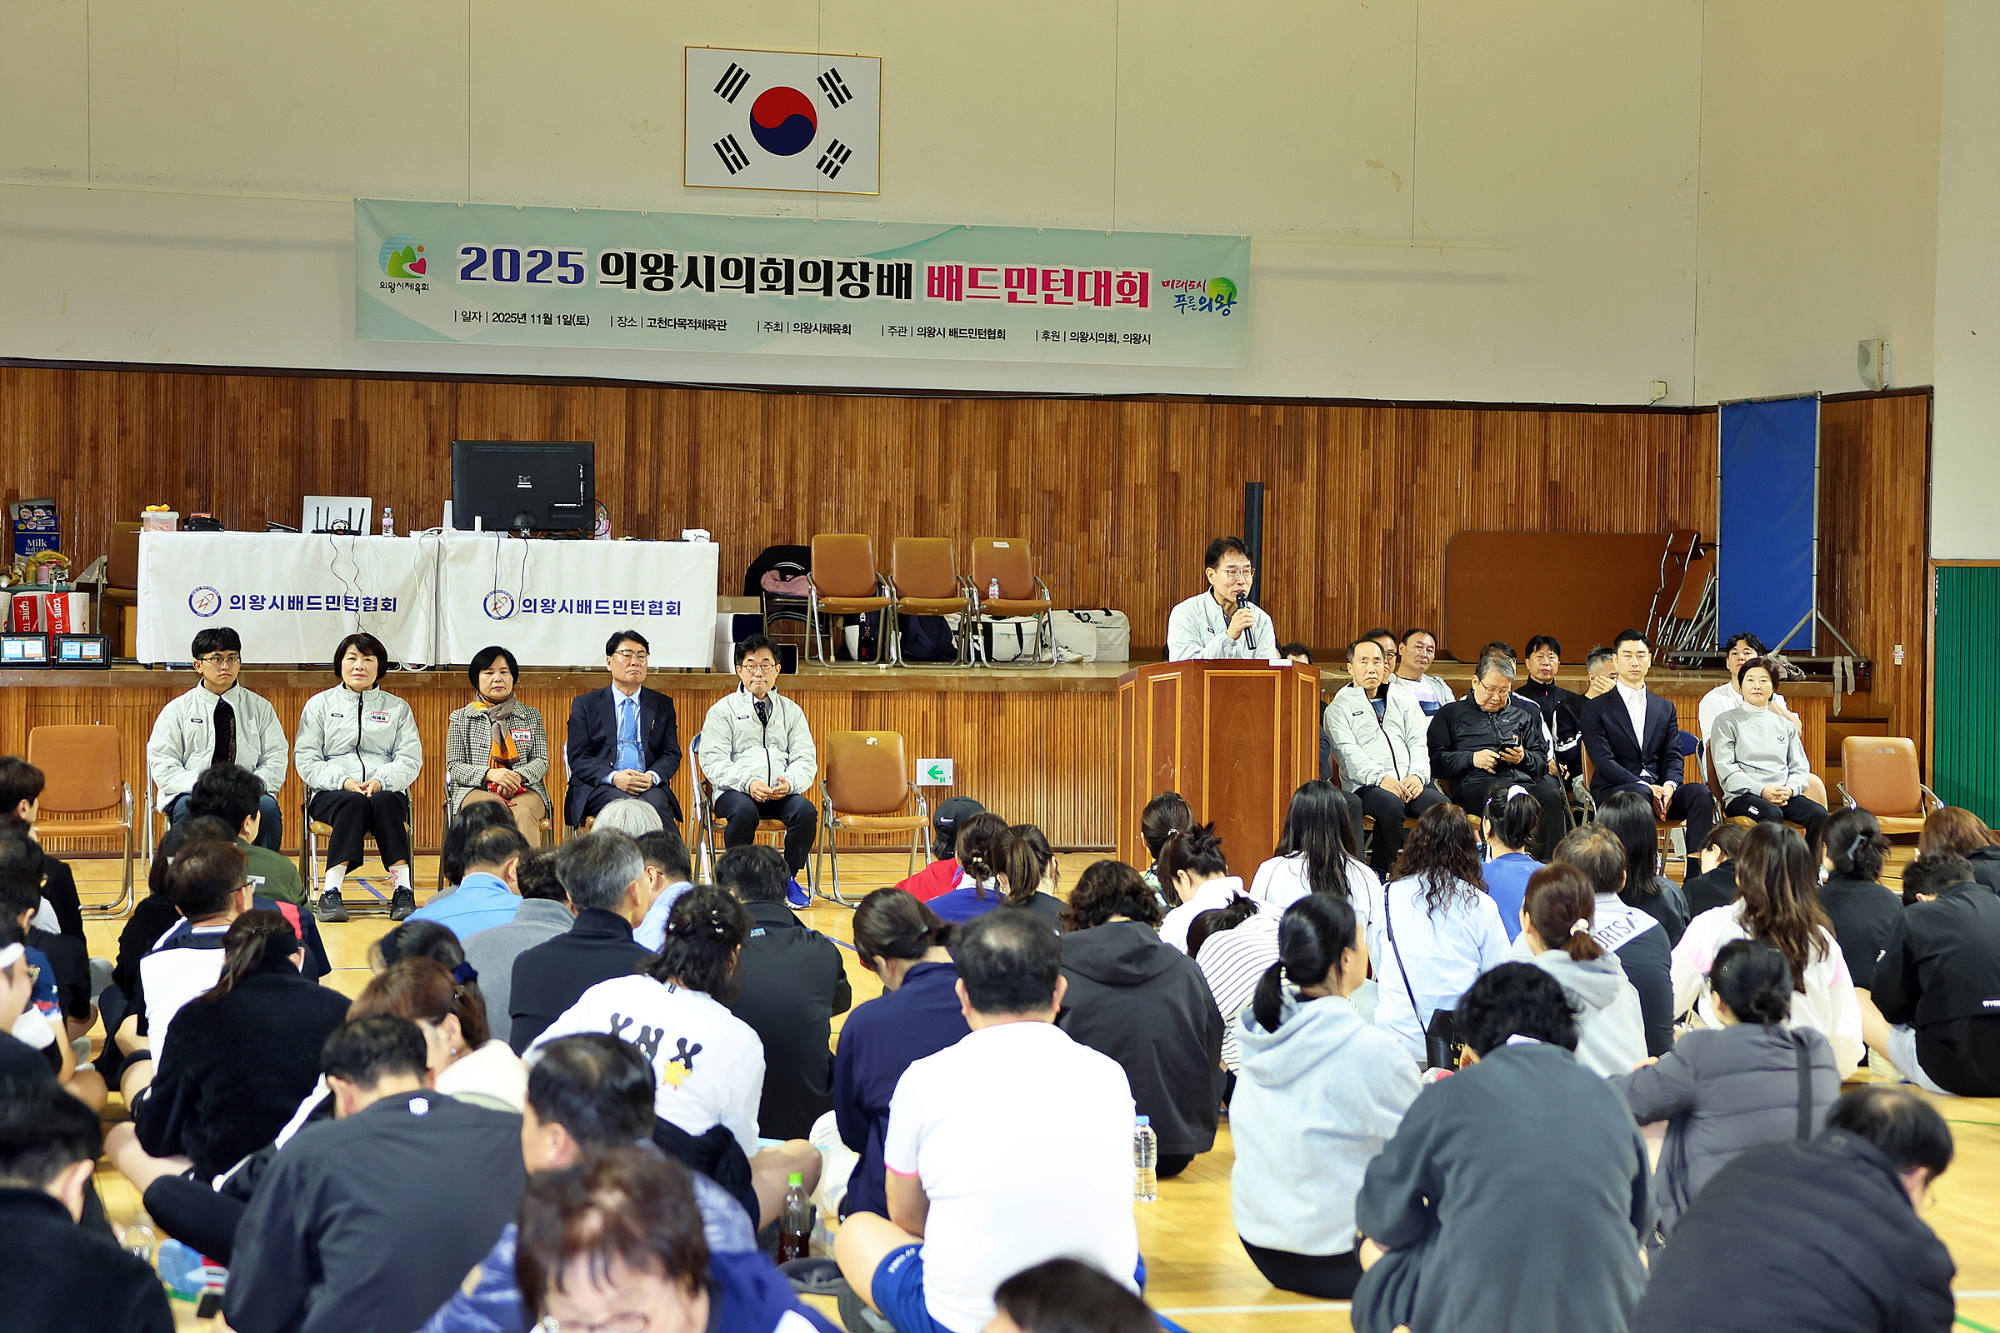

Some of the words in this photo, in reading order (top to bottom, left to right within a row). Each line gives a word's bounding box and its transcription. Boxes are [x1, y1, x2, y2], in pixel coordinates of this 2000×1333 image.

[460, 246, 585, 285] 2025
[600, 251, 913, 300] 의왕시의회의장배
[926, 264, 1149, 308] 배드민턴대회
[1161, 278, 1207, 293] 미래도시
[461, 310, 482, 323] 일자
[492, 312, 527, 324] 2025년
[530, 313, 553, 326] 11월
[556, 313, 590, 327] 1일(토)
[617, 316, 638, 328] 장소
[646, 317, 728, 331] 고천다목적체육관
[763, 321, 783, 333] 주최
[792, 322, 852, 335] 의왕시체육회
[887, 325, 908, 337] 주관
[916, 326, 946, 339] 의왕시
[948, 327, 1006, 341] 배드민턴협회
[1041, 330, 1061, 342] 후원
[1069, 331, 1120, 344] 의왕시의회,
[1122, 333, 1151, 345] 의왕시
[26, 538, 48, 547] Milk
[21, 600, 30, 620] CORE
[53, 598, 62, 618] CORE
[229, 594, 397, 612] 의왕시배드민턴협회
[521, 598, 682, 616] 의왕시배드민턴협회
[23, 621, 31, 632] TO
[55, 619, 63, 630] TO
